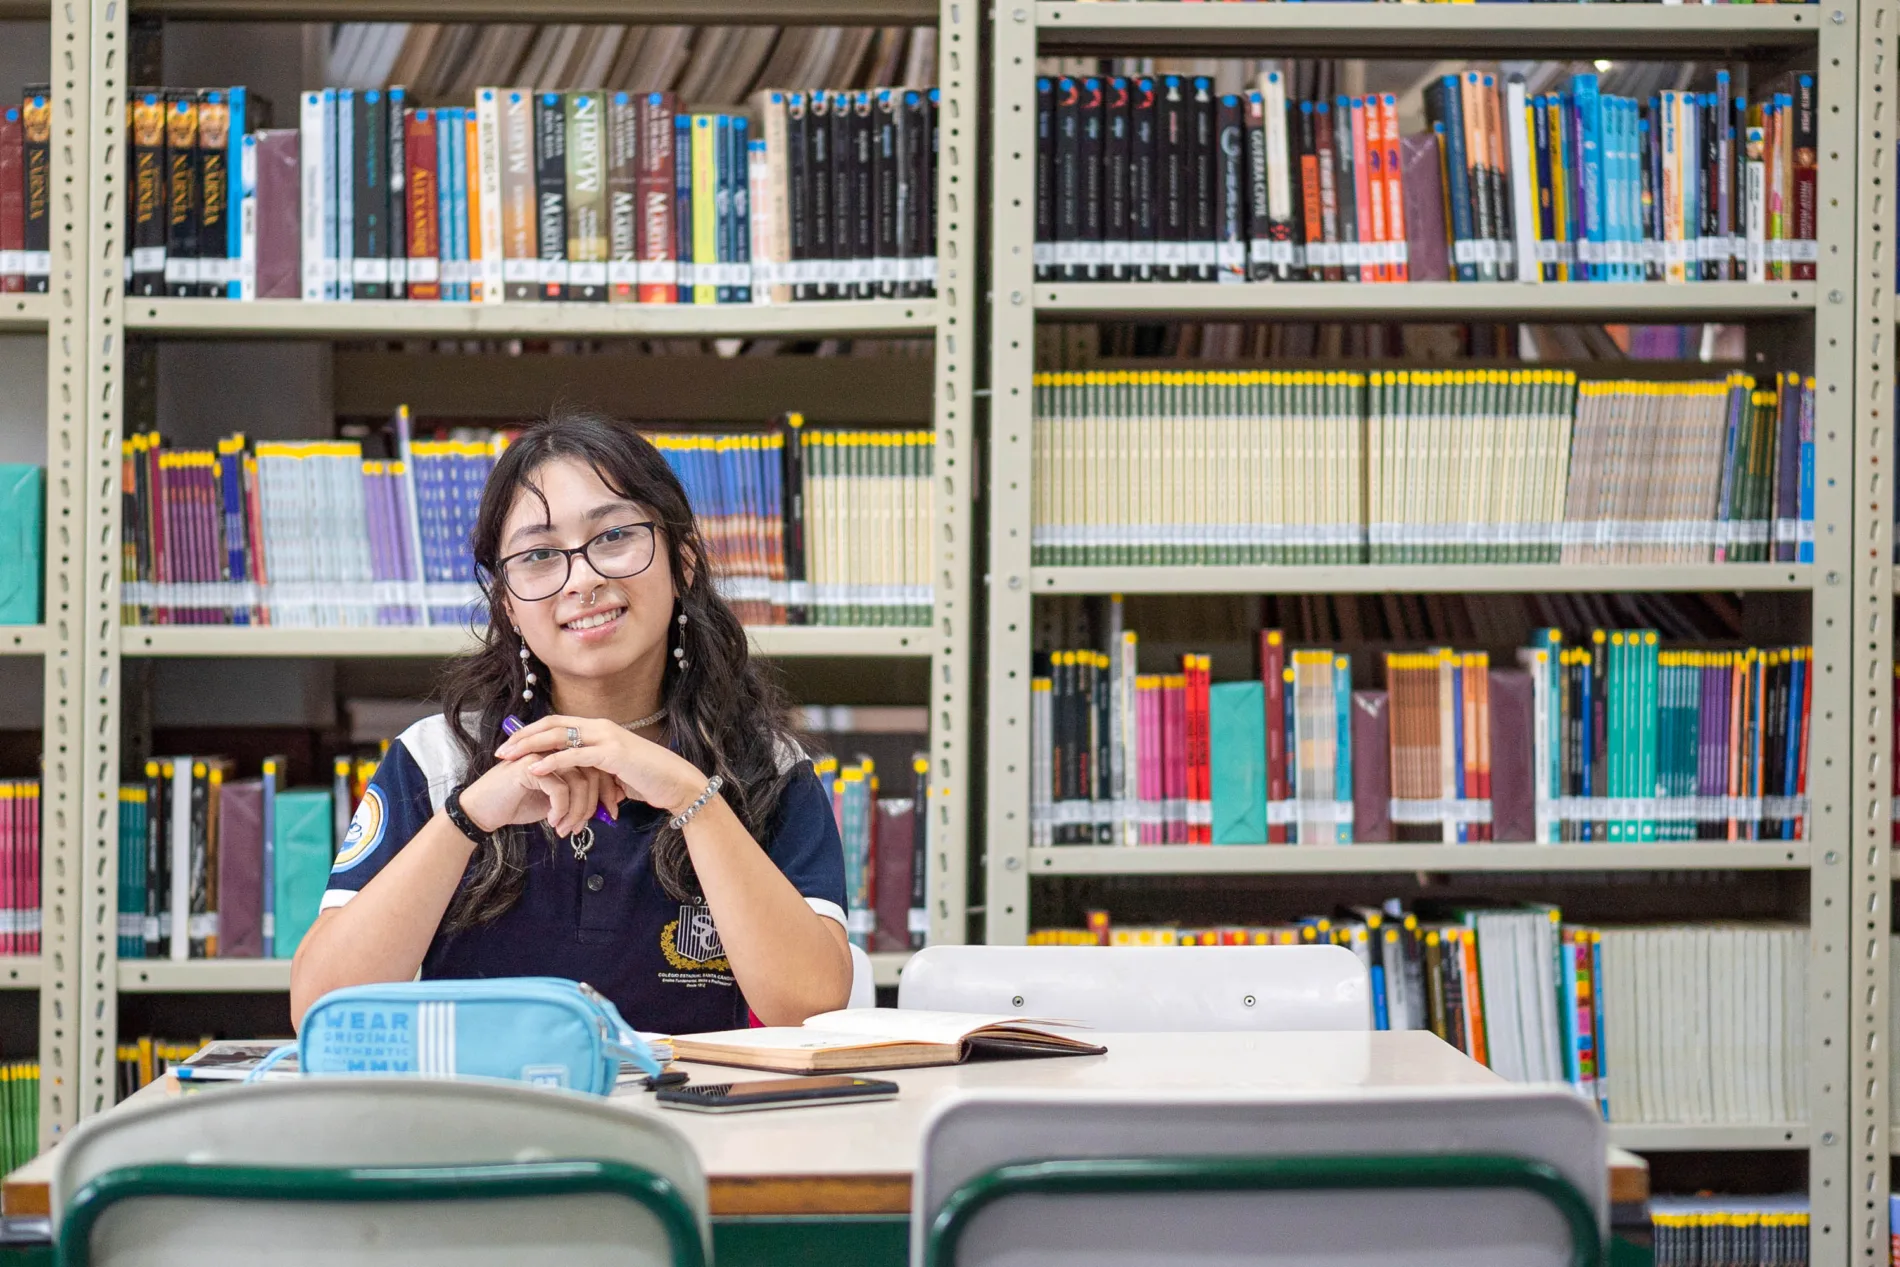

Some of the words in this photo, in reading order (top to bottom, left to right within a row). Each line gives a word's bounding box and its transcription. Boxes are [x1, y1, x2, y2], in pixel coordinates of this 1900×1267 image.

[573, 97, 598, 192] MARTIN
[1251, 130, 1265, 181] GUERRA
[324, 1010, 409, 1030] WEAR
[324, 1031, 409, 1043] ORIGINAL
[324, 1046, 409, 1056] AUTHENTIC
